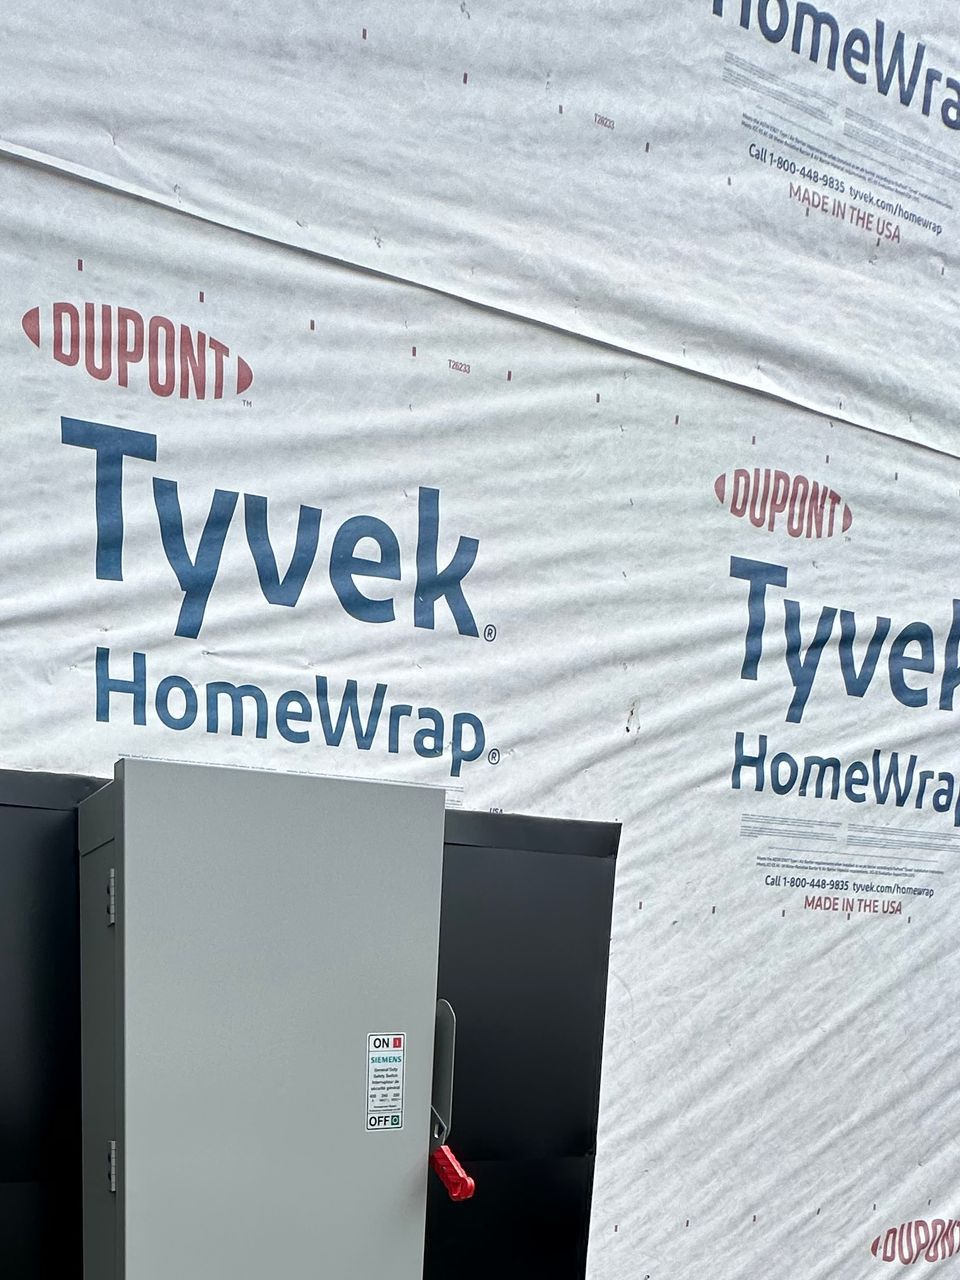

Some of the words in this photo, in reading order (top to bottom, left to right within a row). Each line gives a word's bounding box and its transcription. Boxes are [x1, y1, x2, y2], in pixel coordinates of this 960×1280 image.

[712, 0, 960, 130] omeWra
[749, 143, 767, 164] Call
[769, 152, 845, 193] 1-800-448-9835
[850, 186, 942, 236] tyvek.com/homewrap
[789, 182, 829, 213] MADE
[832, 199, 846, 220] IN
[850, 205, 873, 231] THE
[876, 217, 901, 243] USA
[53, 302, 230, 400] DUPONT
[730, 468, 842, 538] DUPONT
[731, 731, 960, 827] HomeWra
[765, 875, 781, 887] Call
[783, 876, 849, 891] 1-800-448-9835
[852, 882, 935, 899] tyvek.com/homewrap
[804, 895, 839, 911] MADE
[841, 897, 854, 912] IN
[857, 899, 879, 913] THE
[881, 900, 902, 915] USA
[370, 1055, 402, 1064] SIEMENS
[373, 1037, 390, 1048] ON
[368, 1115, 390, 1127] OFF
